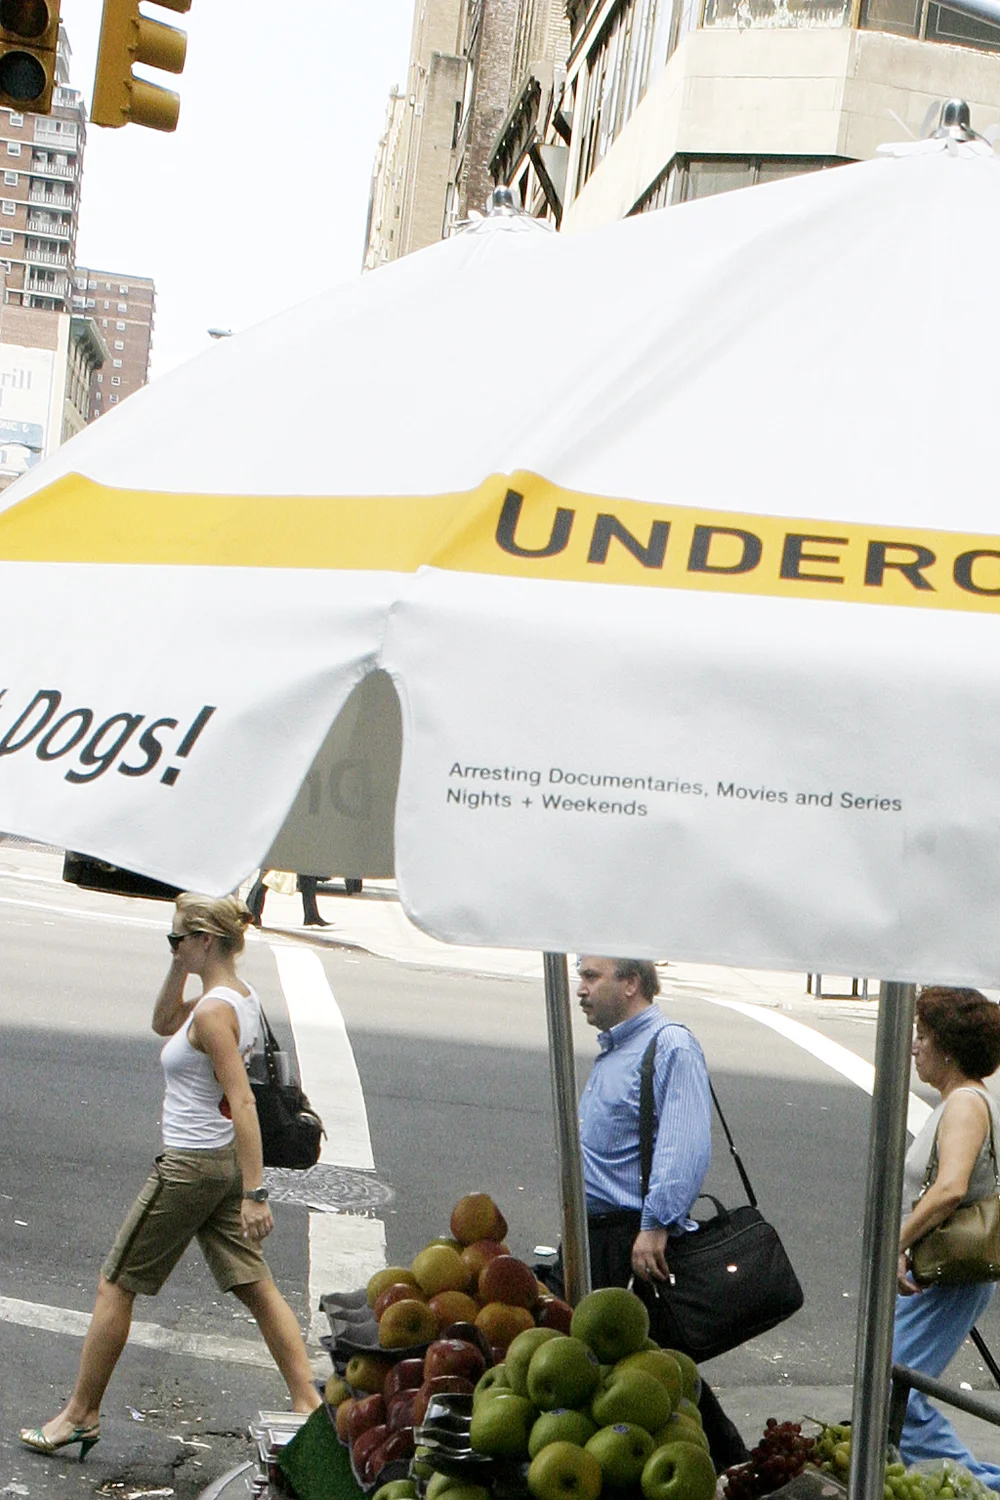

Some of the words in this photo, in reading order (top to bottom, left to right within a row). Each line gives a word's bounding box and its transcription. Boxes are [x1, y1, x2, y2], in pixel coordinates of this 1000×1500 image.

[0, 689, 217, 787] Dogs!
[446, 788, 512, 811] Nights
[522, 796, 533, 807] +
[542, 794, 648, 818] Weekends
[449, 762, 541, 786] Arresting
[548, 768, 708, 797] Documentaries,
[717, 781, 788, 805] Movies
[795, 791, 833, 808] and
[840, 793, 903, 813] Series
